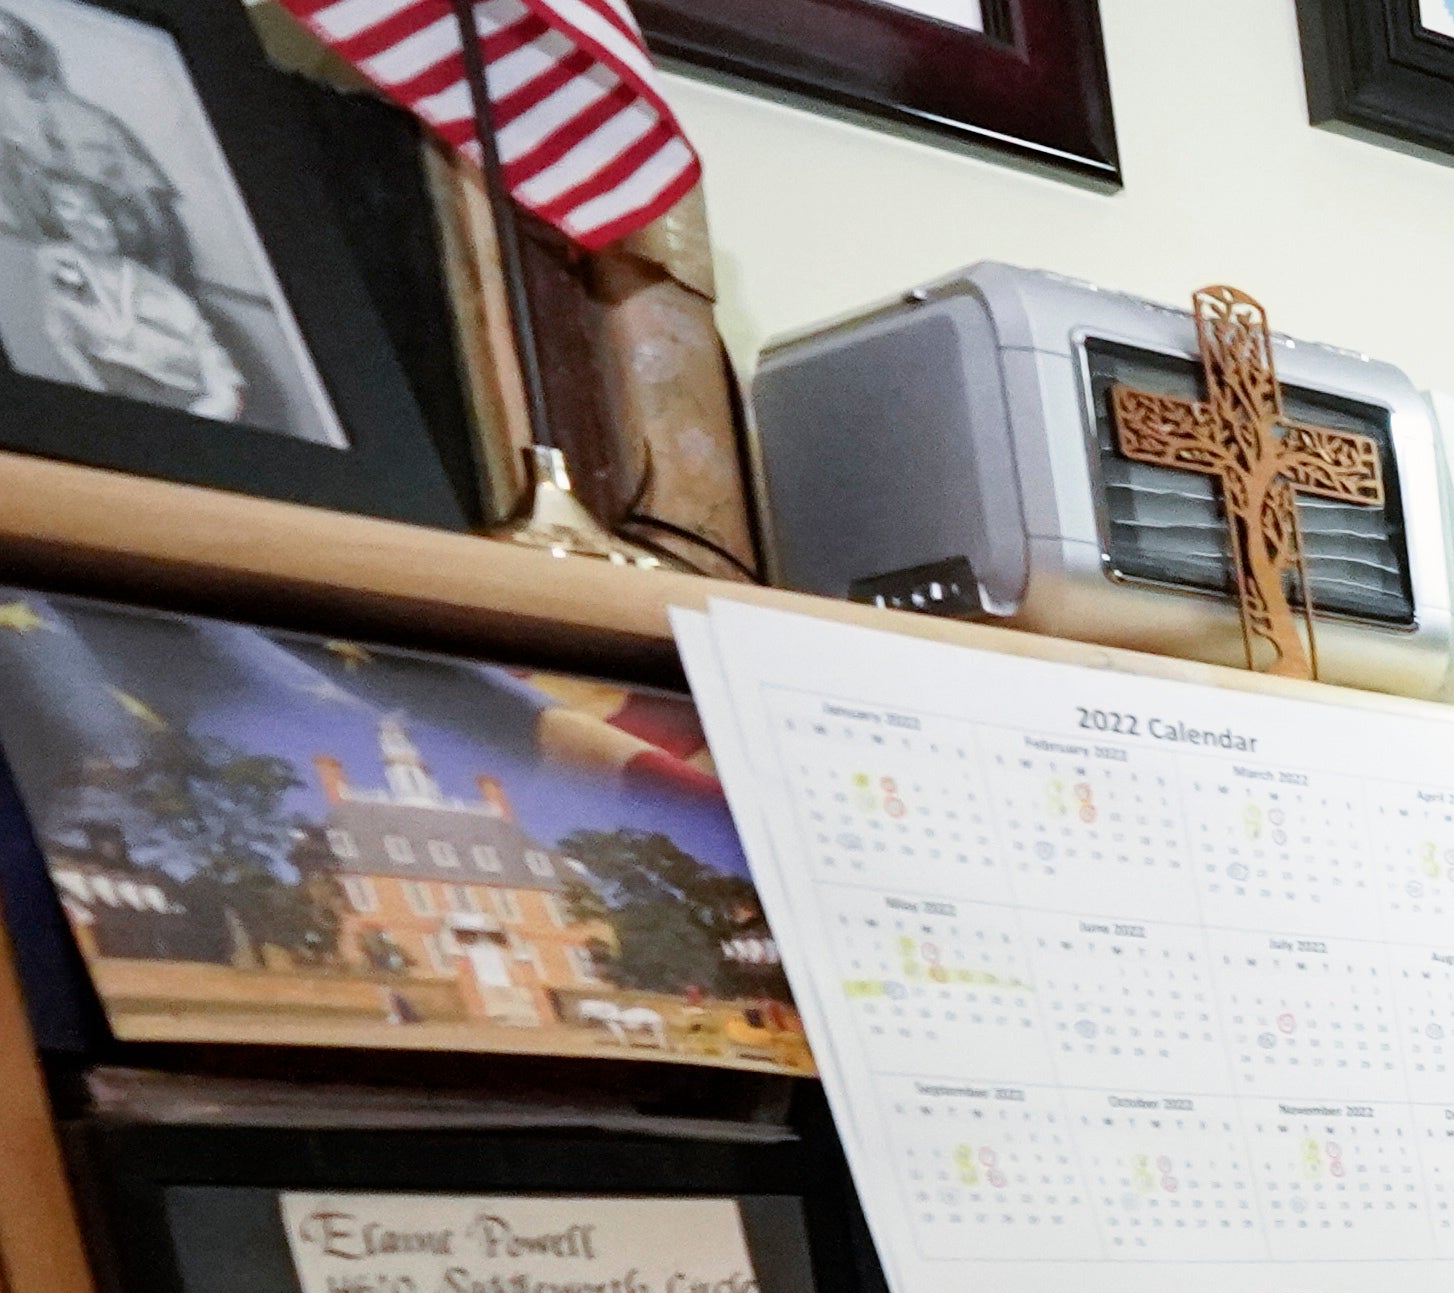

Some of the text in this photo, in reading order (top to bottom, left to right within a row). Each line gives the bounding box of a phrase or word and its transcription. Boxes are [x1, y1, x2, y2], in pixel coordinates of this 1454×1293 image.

[1076, 707, 1259, 753] 2022 Calendar
[1232, 763, 1274, 783] March
[1416, 788, 1445, 806] April
[1269, 937, 1294, 954] July
[300, 1211, 598, 1261] Elaine Powell
